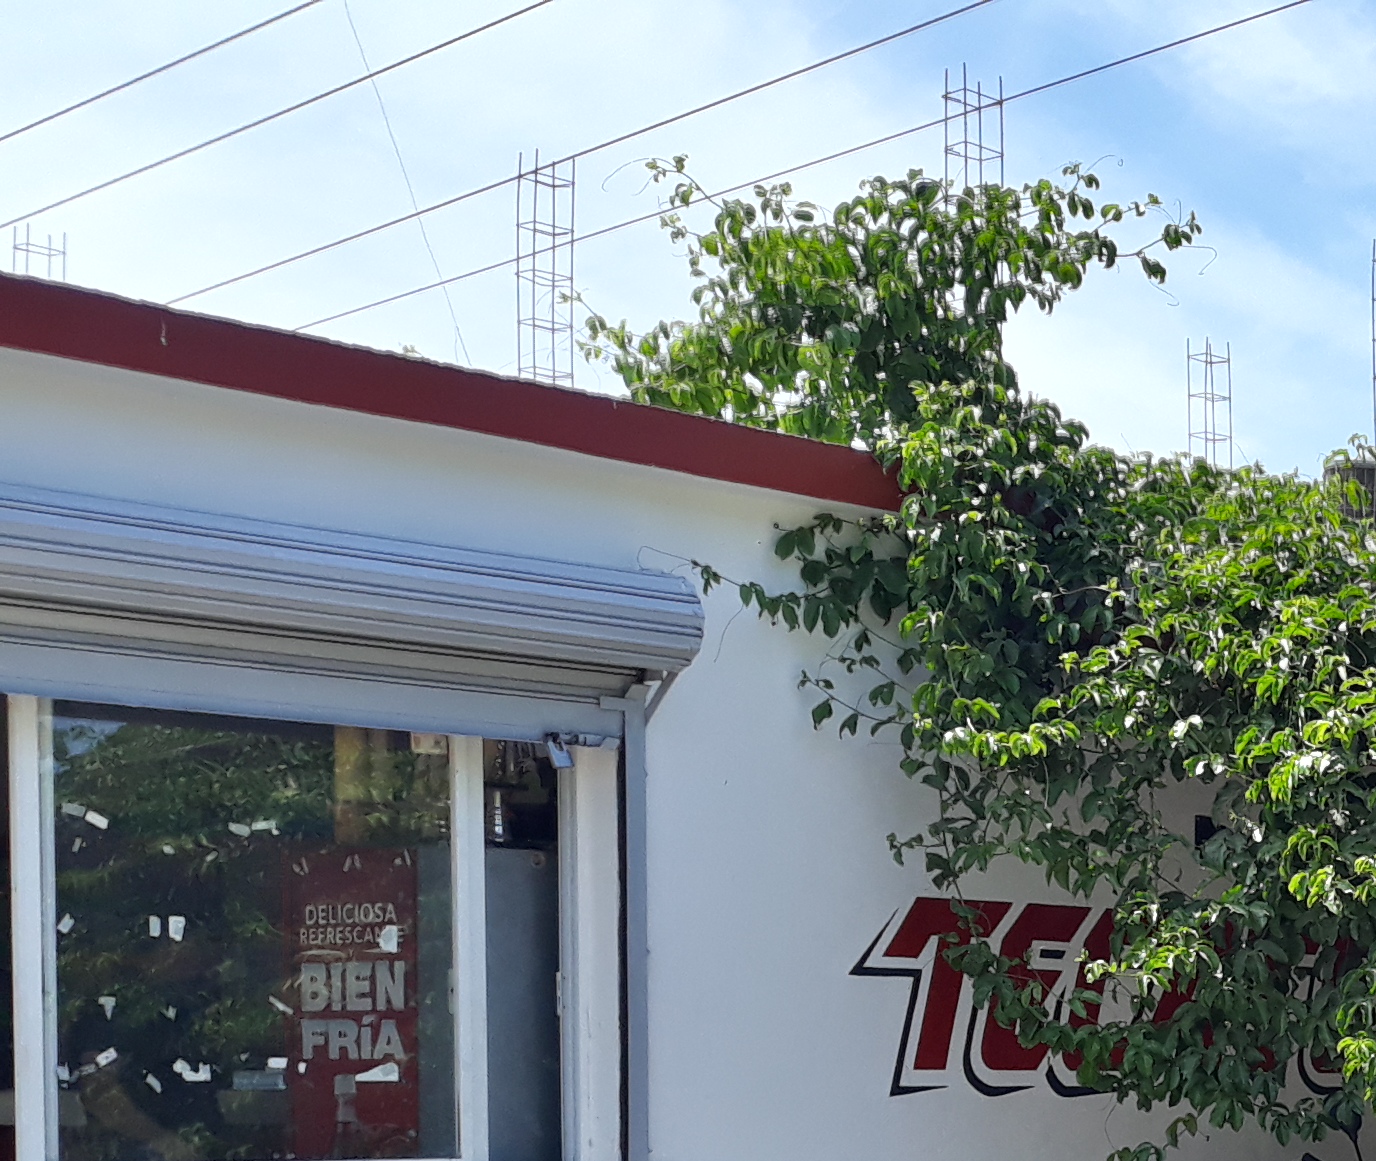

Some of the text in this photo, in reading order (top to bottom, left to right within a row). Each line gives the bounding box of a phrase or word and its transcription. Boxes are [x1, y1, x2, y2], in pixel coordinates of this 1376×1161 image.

[305, 902, 398, 925] DELICIOSA
[300, 925, 405, 946] REFRESCANE
[301, 960, 406, 1012] BIEN
[301, 1014, 406, 1060] FRÍA
